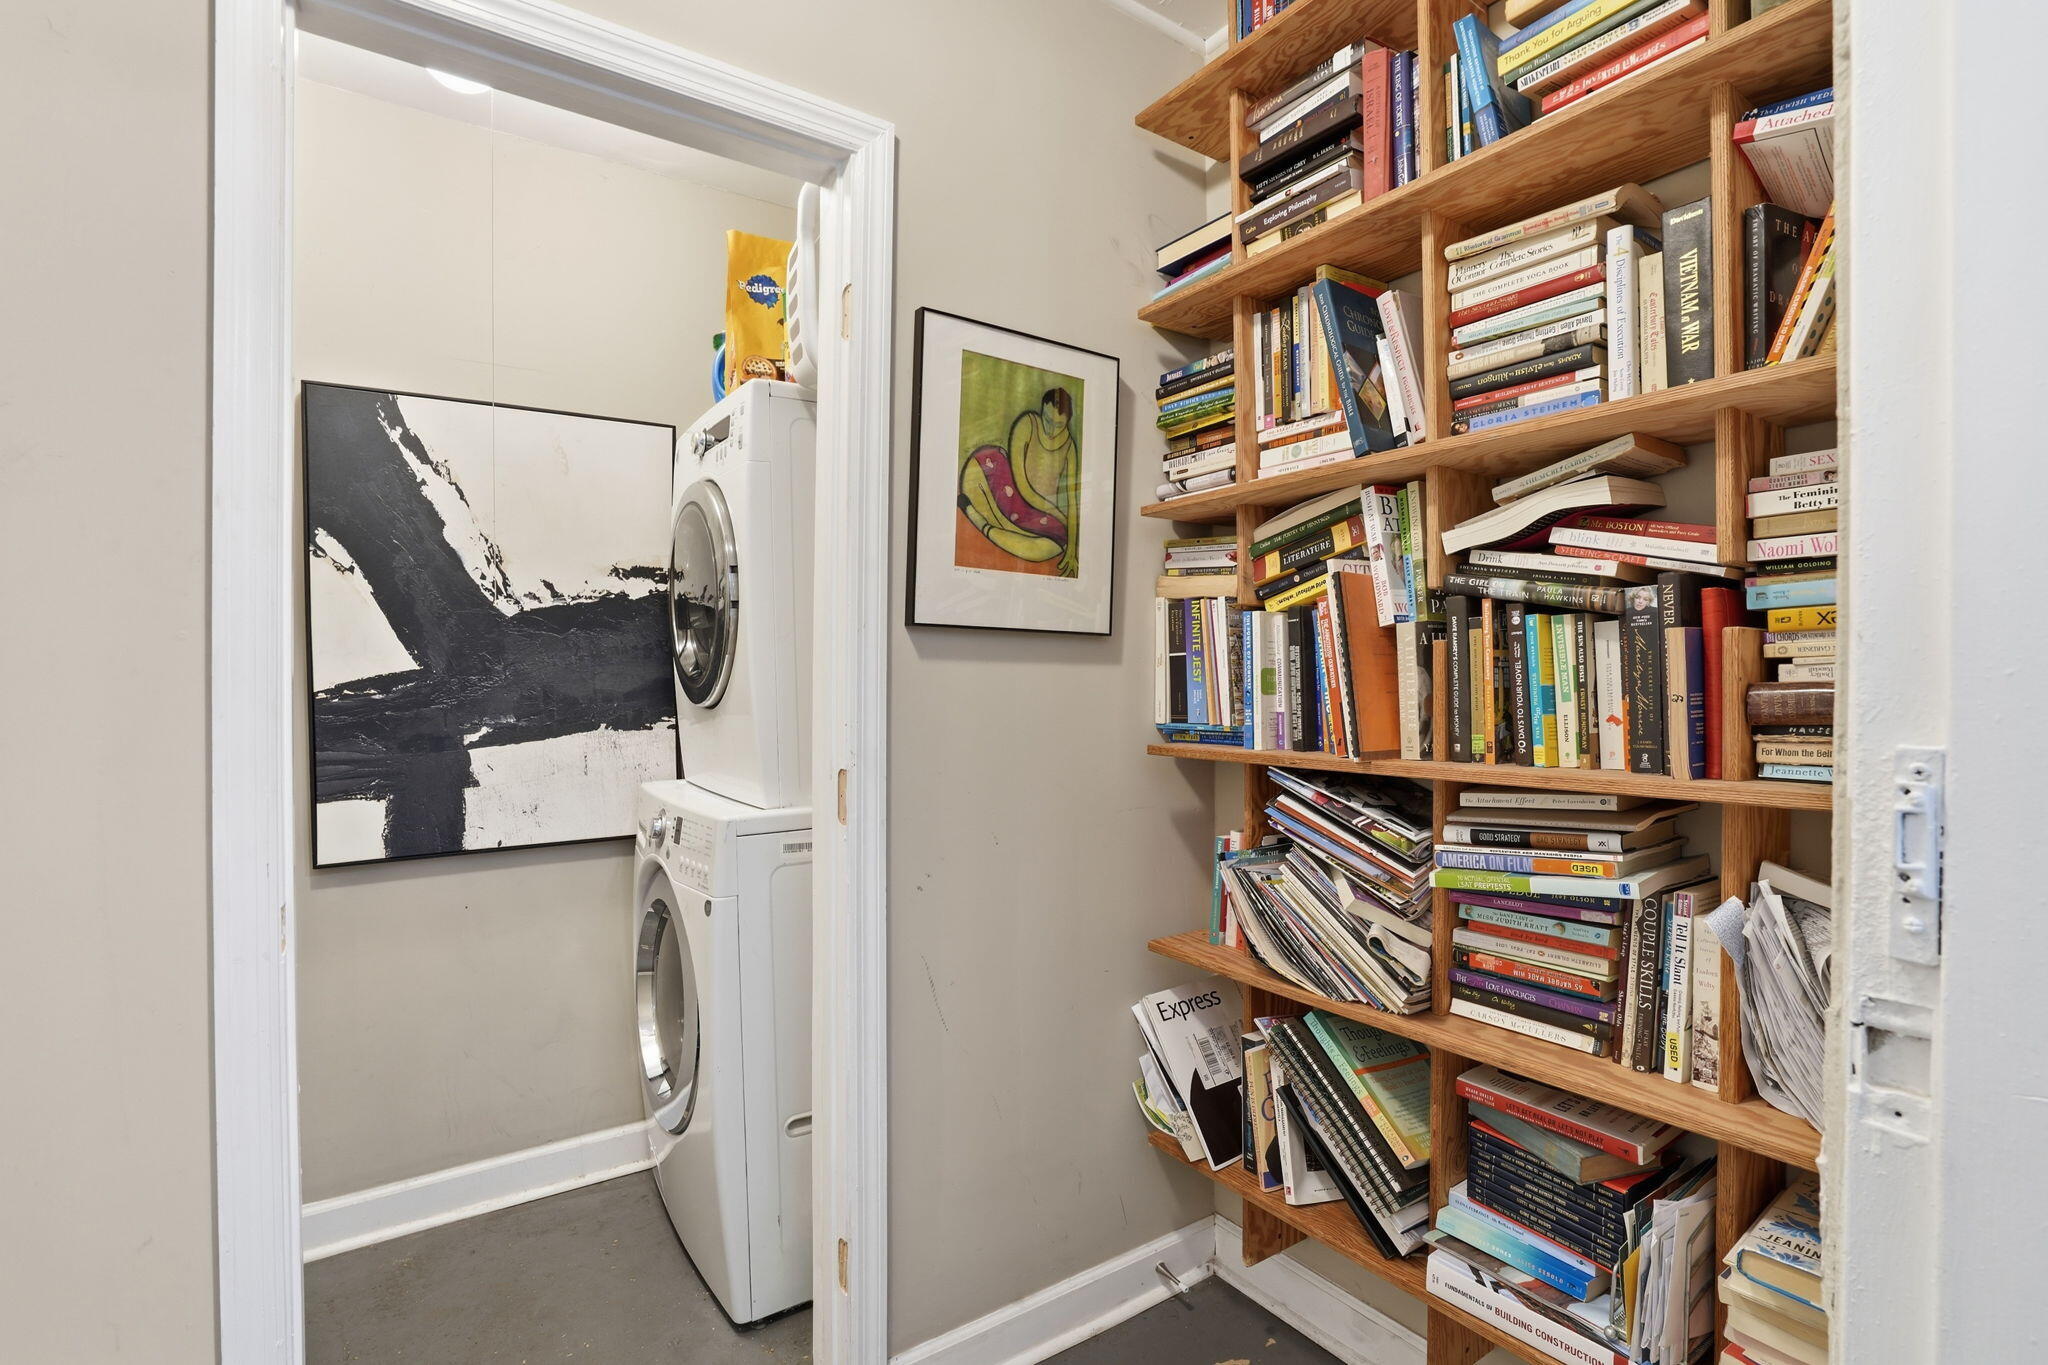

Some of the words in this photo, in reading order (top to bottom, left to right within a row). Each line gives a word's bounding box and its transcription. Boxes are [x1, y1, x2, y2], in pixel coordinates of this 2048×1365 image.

[1504, 47, 1531, 67] Thank
[1532, 36, 1550, 51] You
[1551, 27, 1565, 41] for
[1567, 7, 1602, 33] Arguing
[1773, 97, 1808, 114] JEWISH
[1762, 104, 1834, 130] Attached
[1263, 207, 1288, 226] Exploring
[1288, 194, 1318, 215] Philosophy
[1775, 219, 1798, 238] THE
[1489, 255, 1526, 272] Complete
[1526, 243, 1554, 260] Stories
[1499, 251, 1514, 262] The
[1472, 288, 1486, 299] THE
[1488, 277, 1525, 295] COMPLETE
[1527, 269, 1547, 282] YOGA
[1549, 260, 1570, 274] BOOK
[1615, 257, 1626, 302] Disciplines
[1679, 247, 1700, 314] VIETNAM
[1616, 303, 1625, 315] of
[1560, 320, 1576, 332] Allen
[1576, 315, 1594, 327] David
[1515, 332, 1535, 345] Things
[1535, 326, 1556, 339] Getting
[1616, 316, 1626, 361] Execution
[1681, 320, 1701, 355] WAR
[1390, 331, 1407, 371] RESPECT
[1500, 338, 1515, 349] Done
[1471, 413, 1518, 429] GLORIA
[1523, 399, 1578, 417] STEINEM
[1809, 452, 1837, 467] SEX
[1364, 489, 1373, 514] BUSH
[1793, 498, 1824, 510] Betty
[1410, 490, 1418, 535] KNOWING
[1605, 520, 1645, 533] BOSTON
[1569, 531, 1601, 546] blink
[1283, 543, 1331, 565] LITERATURE
[1477, 551, 1504, 564] Drink
[1756, 539, 1804, 559] Naomi
[1612, 552, 1642, 564] CRAFT
[1797, 560, 1832, 569] GOLDING
[1373, 564, 1385, 616] WOODWARD
[1449, 576, 1466, 585] THE
[1468, 577, 1490, 588] GIRL
[1536, 585, 1563, 595] PAULA
[1477, 586, 1496, 596] THE
[1543, 593, 1584, 604] HAWKINS
[1662, 583, 1675, 626] NEVER
[1191, 600, 1201, 652] INFINITE
[1577, 633, 1585, 647] SUN
[1776, 631, 1800, 642] CHORDS
[1555, 623, 1568, 675] INVISIBLE
[1633, 628, 1647, 688] Marilyn
[1192, 655, 1202, 683] JEST
[1514, 660, 1522, 686] NOVEL
[1561, 674, 1570, 694] MAN
[1515, 686, 1523, 708] YOUR
[1516, 708, 1524, 719] TO
[1517, 719, 1525, 740] DAYS
[1518, 740, 1526, 755] 90
[1761, 747, 1773, 757] For
[1775, 747, 1799, 757] Whom
[1801, 748, 1815, 758] the
[1769, 765, 1824, 779] Jeannette
[1475, 796, 1513, 805] Attachment
[1514, 796, 1536, 806] Effect
[1478, 832, 1493, 842] GOOD
[1494, 833, 1522, 844] STRATEGY
[1441, 852, 1487, 869] AMERICA
[1488, 855, 1501, 870] ON
[1506, 856, 1532, 873] FILM
[1571, 864, 1598, 873] USED
[1457, 881, 1473, 889] LSAT
[1473, 882, 1512, 891] PREPTESTS
[1493, 899, 1524, 909] LANCELOT
[1476, 912, 1494, 922] MISS
[1495, 915, 1523, 927] JUDITH
[1524, 921, 1549, 933] KRATT
[1641, 898, 1657, 958] COUPLE
[1675, 922, 1689, 943] Tell
[1674, 943, 1686, 955] It
[1547, 952, 1571, 964] GILBERT
[1570, 956, 1602, 970] ELIZABETH
[1455, 972, 1468, 983] THE
[1512, 969, 1526, 978] HIM
[1528, 973, 1546, 984] MADE
[1672, 955, 1685, 987] Slant
[1485, 982, 1502, 993] LOVE
[1501, 986, 1537, 1001] LANGUAGES
[1547, 977, 1573, 989] NATURE
[1574, 983, 1584, 992] AS
[1638, 960, 1655, 1010] SKILLS
[1157, 989, 1222, 1022] Express
[1470, 1009, 1506, 1026] CARSON
[1310, 1018, 1333, 1054] Thoughts
[1339, 1062, 1363, 1096] Feelings
[1669, 1038, 1679, 1063] USED
[1444, 1282, 1485, 1306] FUNDAMENTALS
[1485, 1302, 1493, 1312] OF
[1494, 1306, 1534, 1335] BUILDING
[1534, 1323, 1606, 1365] CONSTRUCTION
